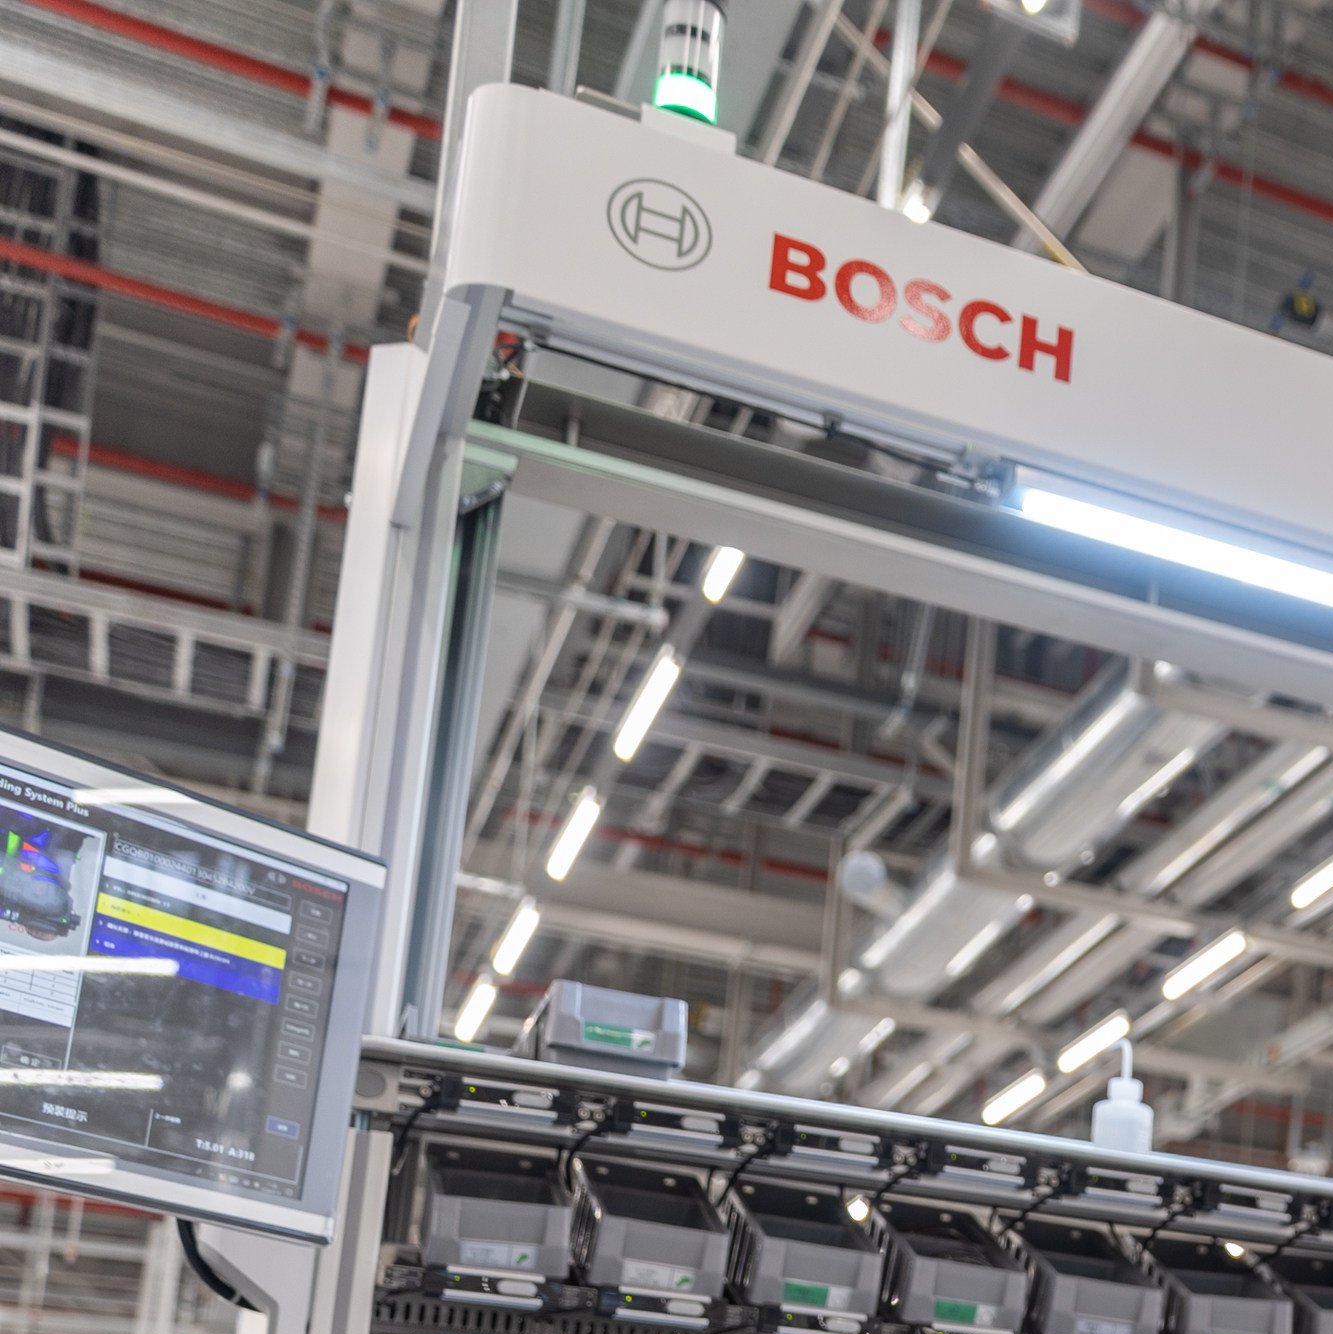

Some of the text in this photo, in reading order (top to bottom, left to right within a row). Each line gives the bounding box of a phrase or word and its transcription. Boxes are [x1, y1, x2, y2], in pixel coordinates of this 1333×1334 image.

[768, 233, 1074, 384] BOSCH
[24, 786, 64, 809] System
[66, 801, 90, 818] Plus
